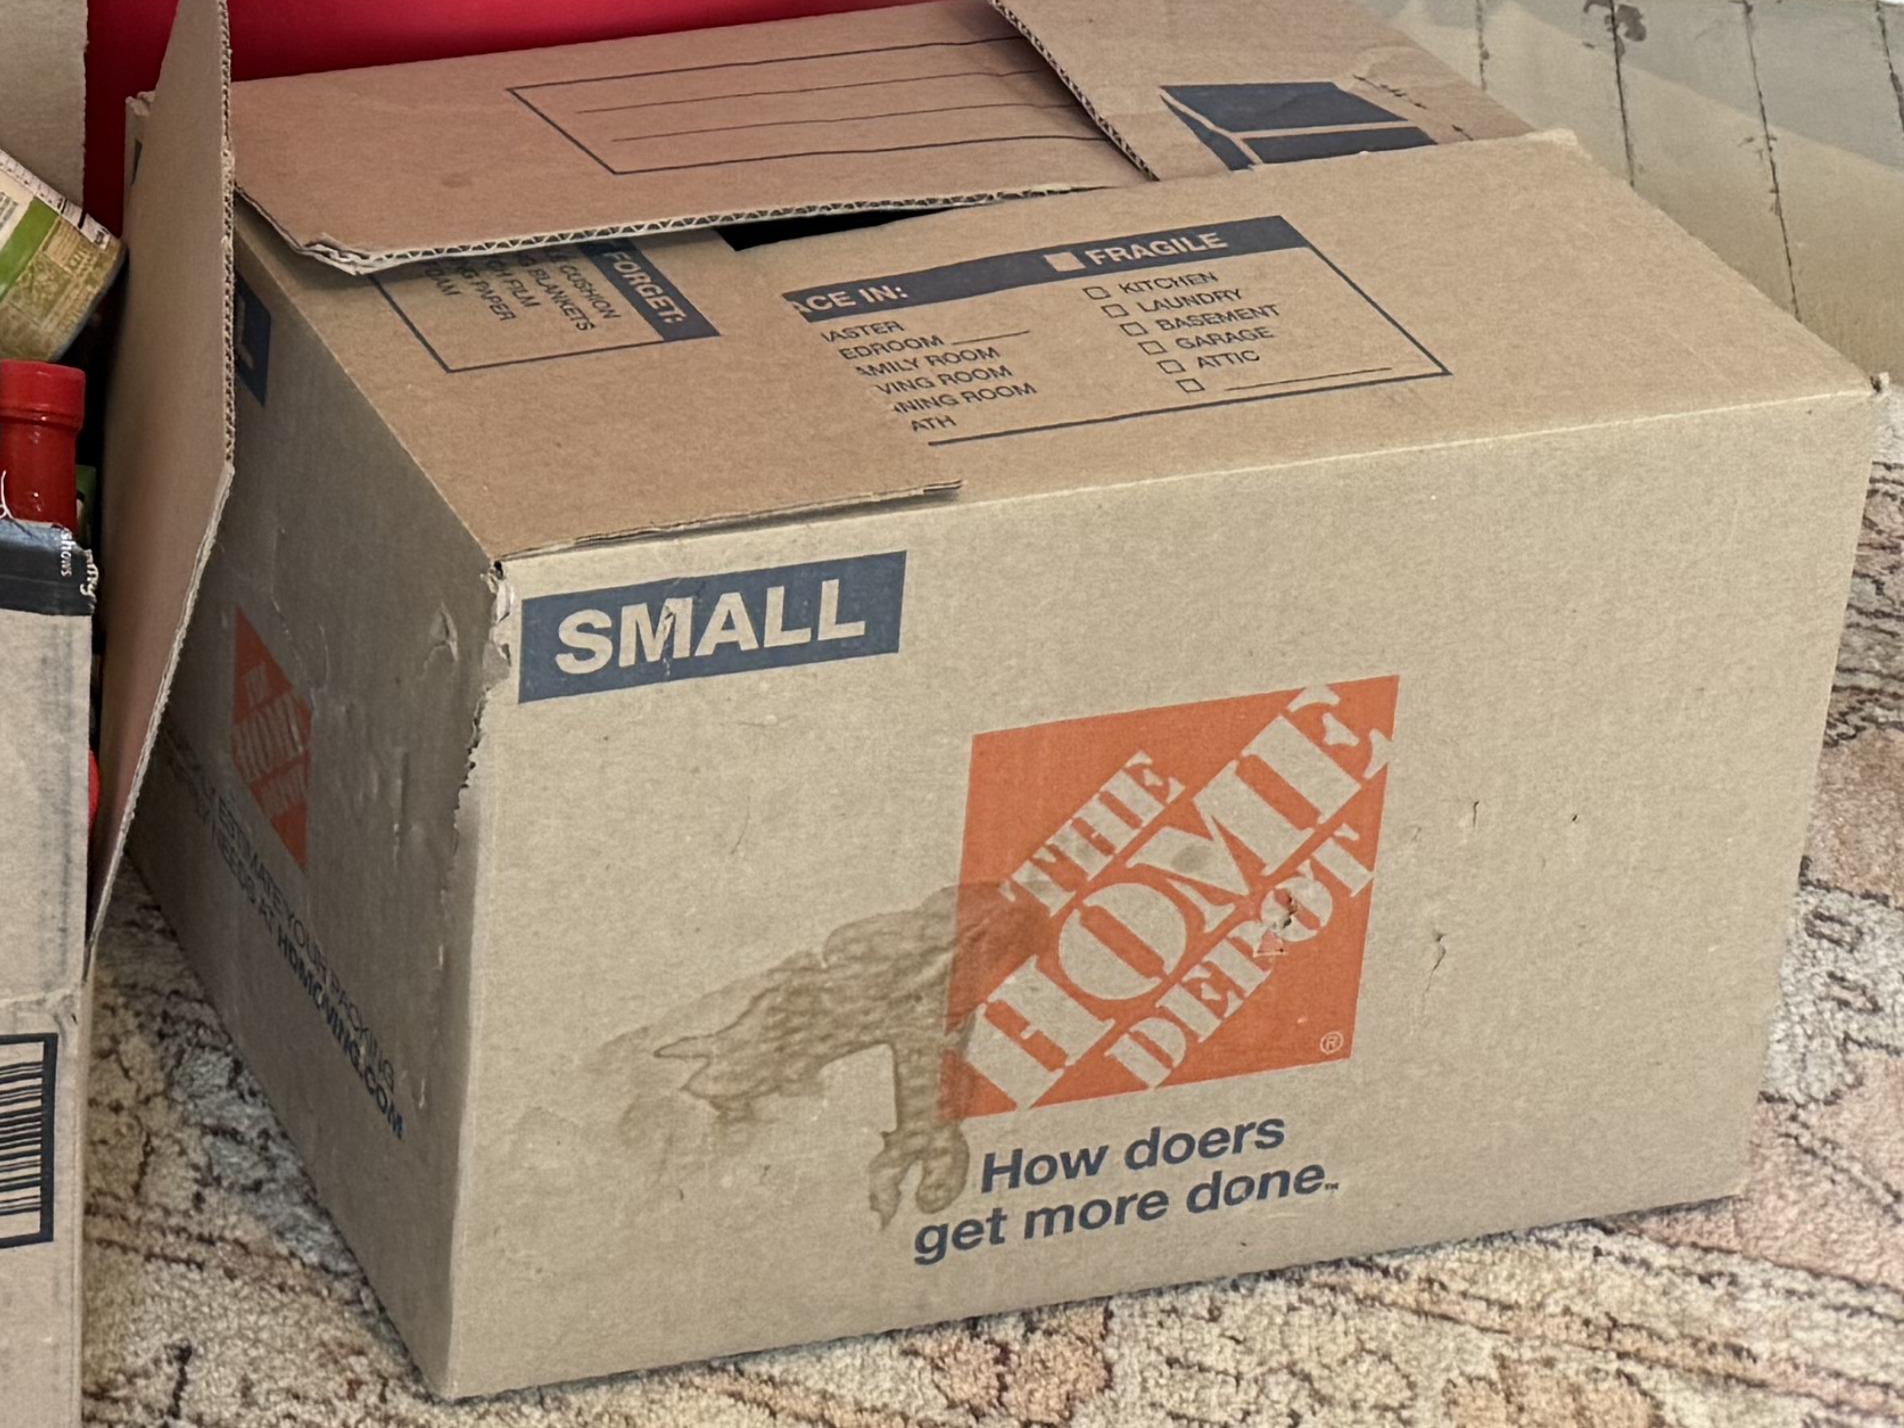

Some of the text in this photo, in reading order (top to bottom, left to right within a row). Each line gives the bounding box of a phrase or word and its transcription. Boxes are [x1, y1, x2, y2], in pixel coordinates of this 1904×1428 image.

[472, 277, 517, 323] PAPER
[503, 270, 540, 308] FILM
[528, 264, 596, 331] BLANKETS
[560, 263, 621, 320] CUSHION
[603, 250, 687, 325] FORGET:
[859, 231, 1228, 308] IN: FRAGILE
[1119, 271, 1219, 296] KITCHEN
[839, 287, 1244, 360] EDROOM LAUNDRY
[856, 303, 1281, 377] AMILY ROOM BASEMENT
[940, 324, 1276, 386] ROOM GARAGE
[963, 348, 1262, 403] ROOM ATTIC
[554, 574, 866, 677] SMALL
[1000, 753, 1191, 917] THE
[962, 685, 1390, 1112] HOME
[1102, 823, 1379, 1090] DEPOT
[980, 1111, 1285, 1194] How doers
[912, 1208, 1010, 1266] get
[1023, 1185, 1168, 1244] more
